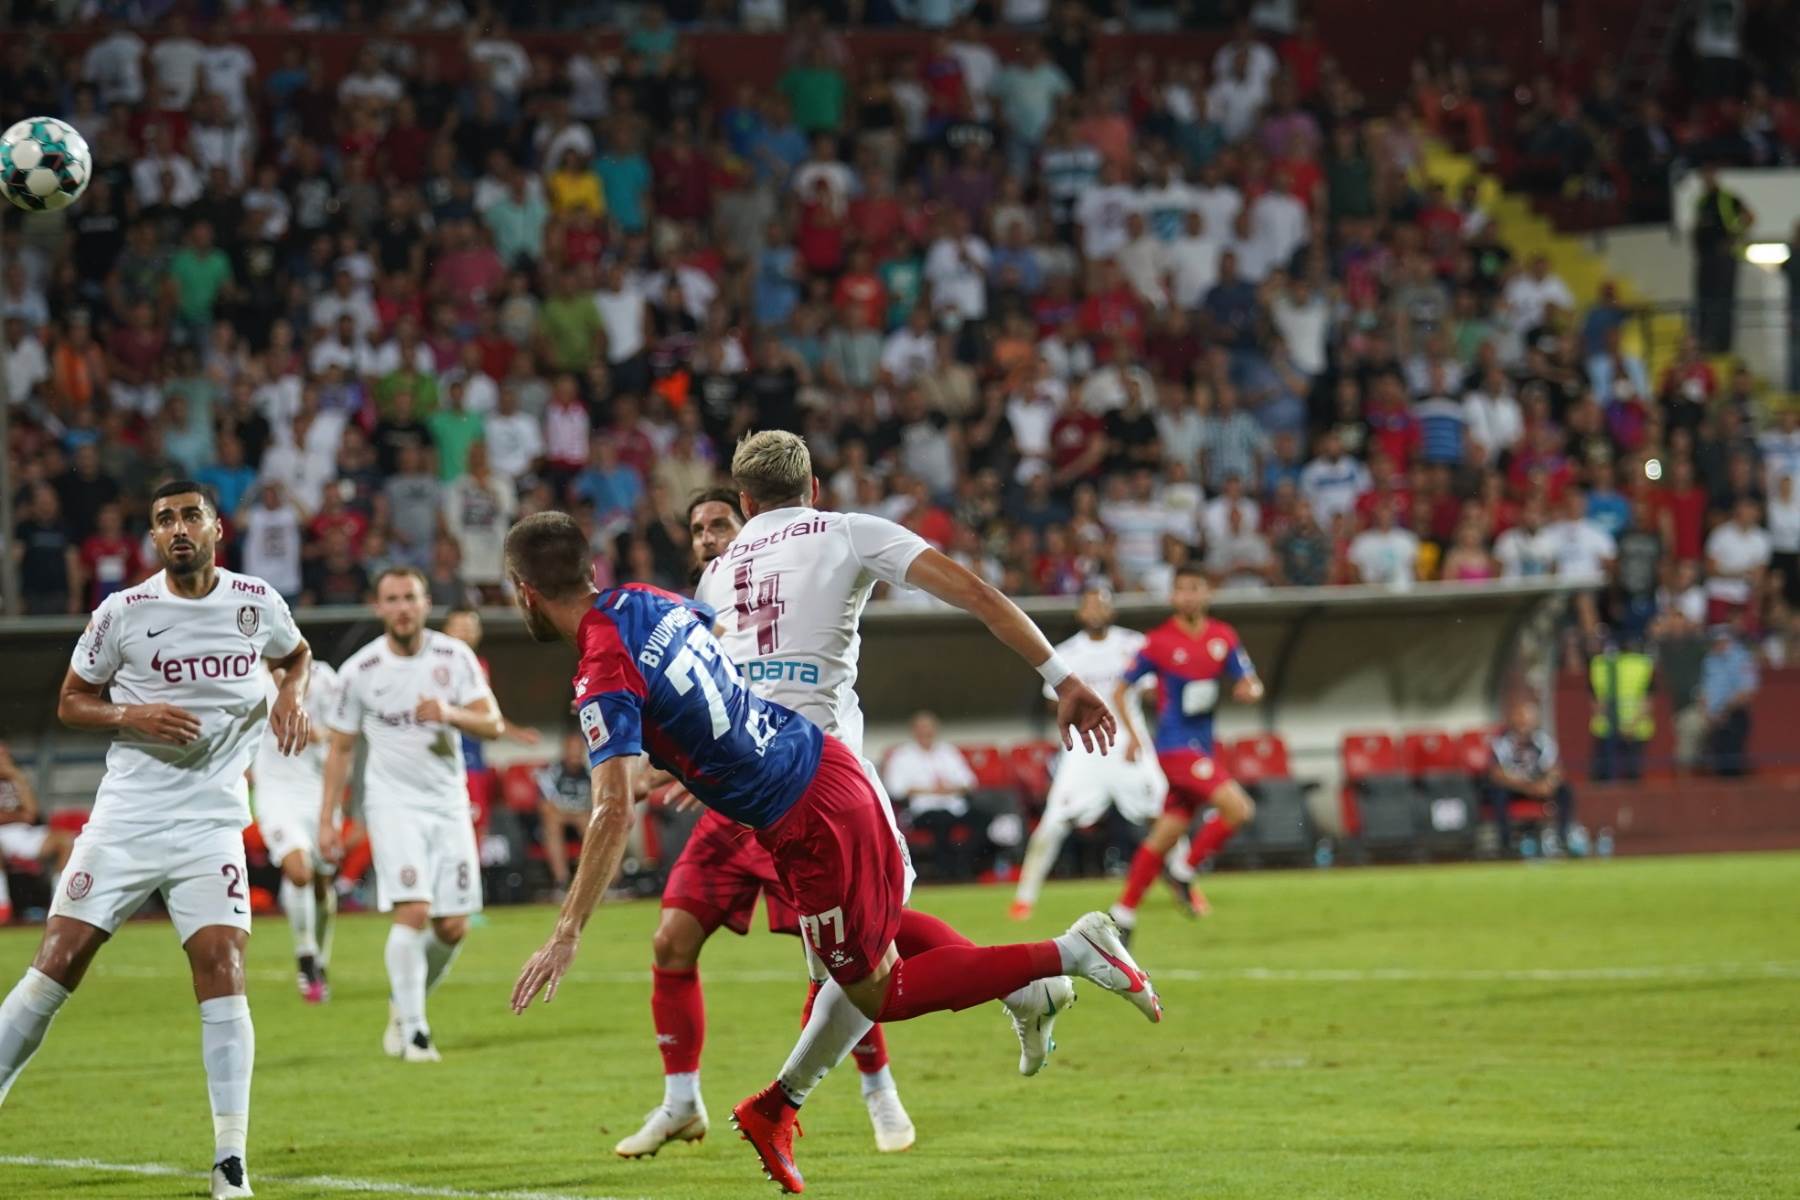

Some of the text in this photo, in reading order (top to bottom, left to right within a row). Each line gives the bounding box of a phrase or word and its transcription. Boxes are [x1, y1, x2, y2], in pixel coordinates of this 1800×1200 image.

[731, 516, 829, 560] betfair
[232, 580, 266, 595] RMB
[734, 558, 785, 656] 4
[90, 610, 114, 655] betfair
[220, 863, 249, 900] 2
[799, 905, 845, 949] 77
